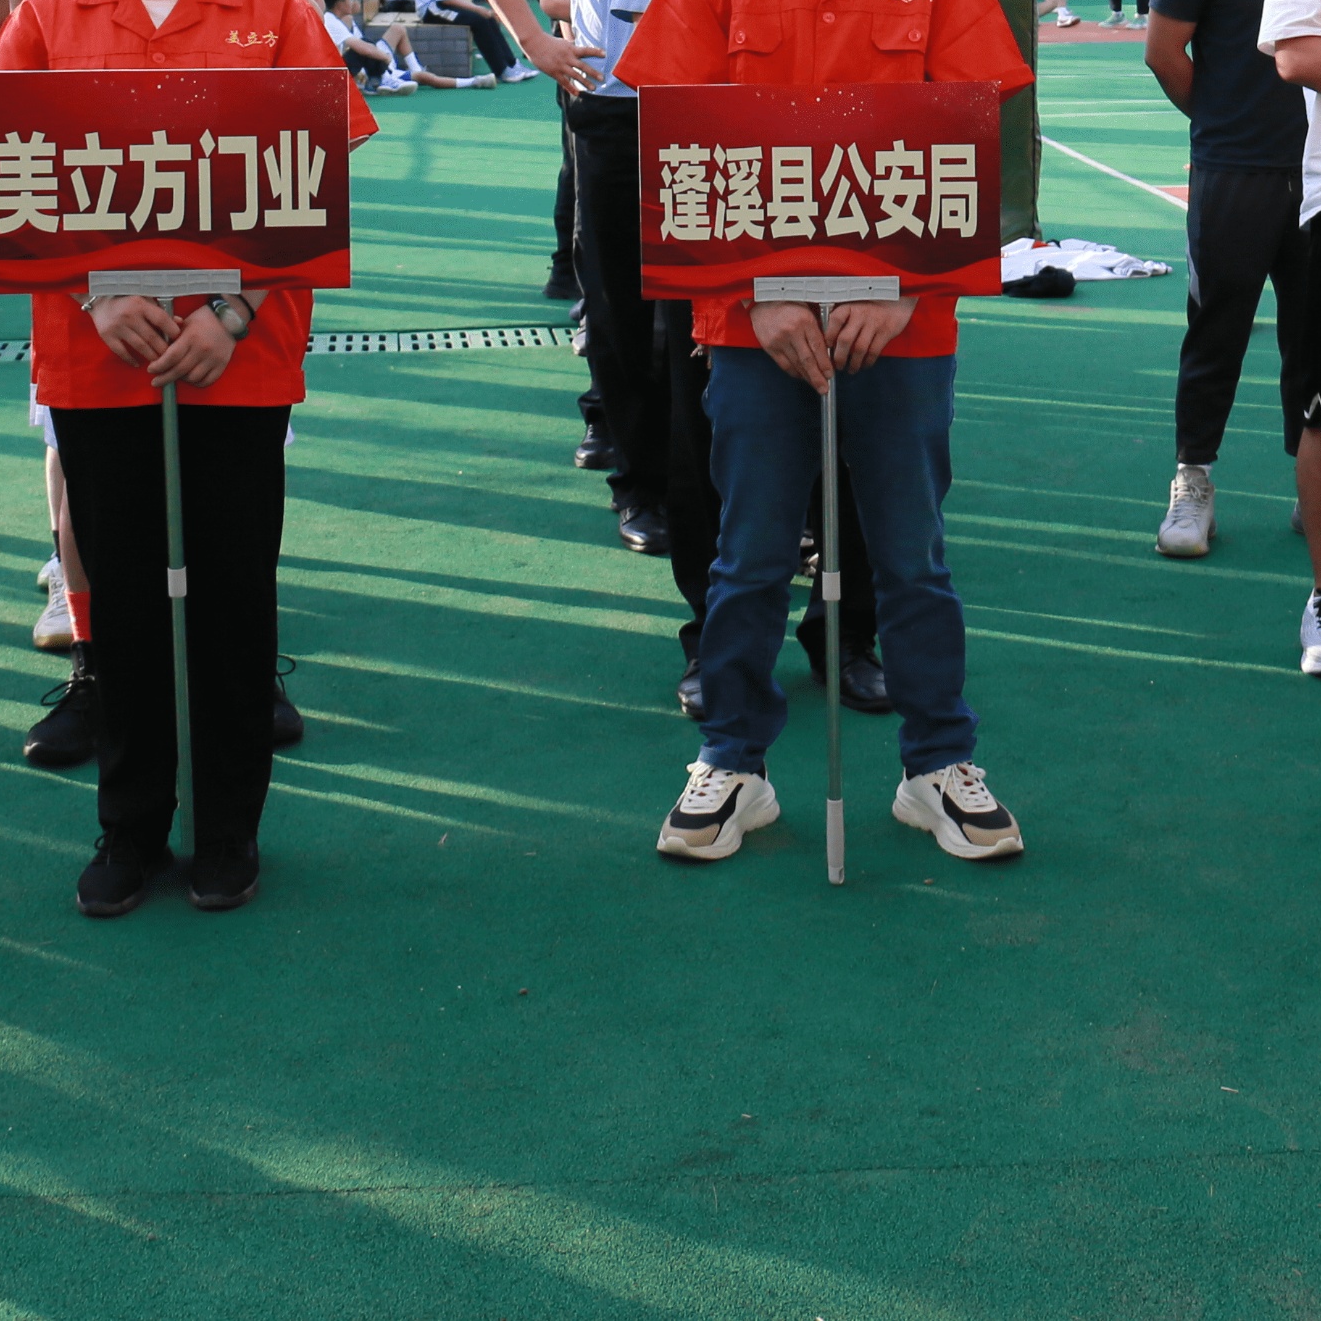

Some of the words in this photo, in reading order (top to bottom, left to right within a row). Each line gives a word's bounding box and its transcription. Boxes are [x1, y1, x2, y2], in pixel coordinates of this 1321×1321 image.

[658, 139, 979, 242] 蓬溪县公安局
